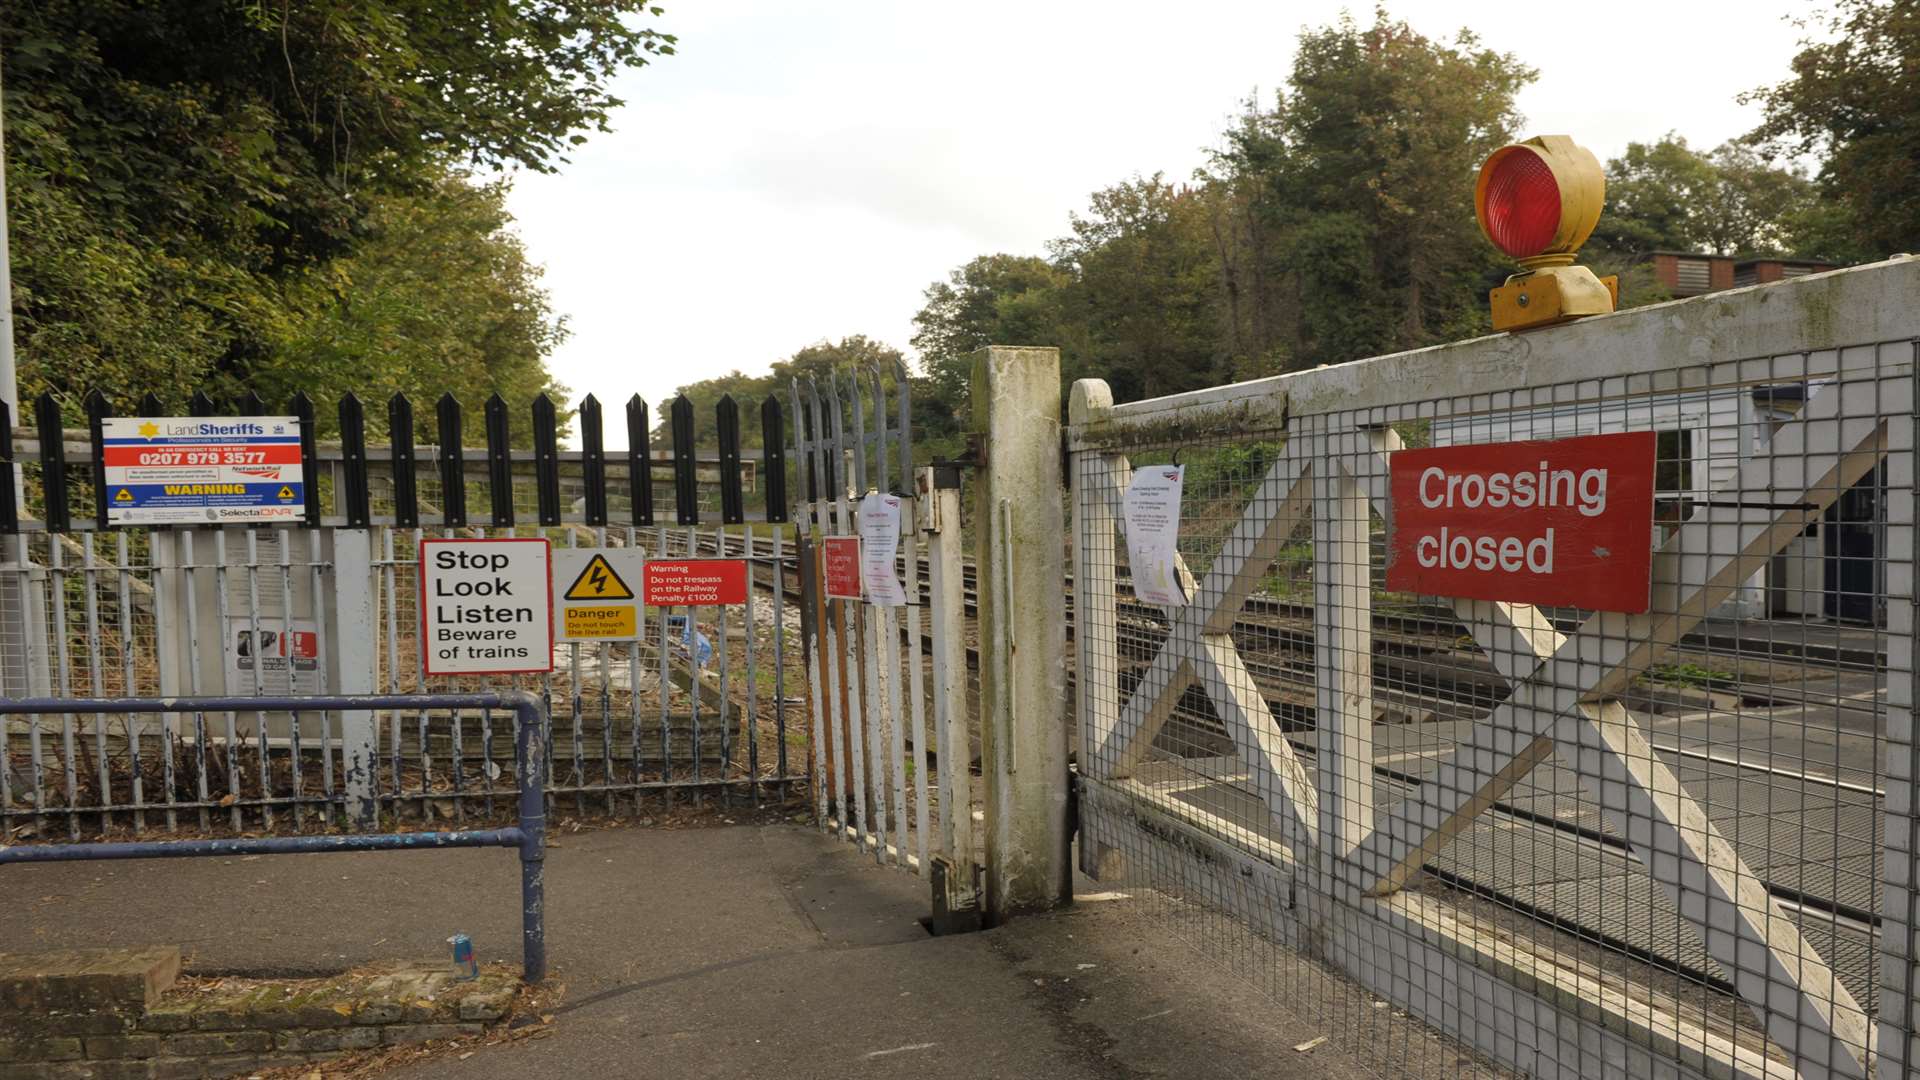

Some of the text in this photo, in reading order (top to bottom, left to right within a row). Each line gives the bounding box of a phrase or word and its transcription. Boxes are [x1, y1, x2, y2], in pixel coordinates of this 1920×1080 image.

[167, 424, 264, 436] LandSheriffs
[139, 452, 266, 465] 0207 979 3577
[164, 484, 246, 496] WARNING
[1419, 461, 1608, 517] Crossing
[1416, 527, 1555, 574] closed
[436, 550, 509, 573] Stop
[650, 565, 689, 573] Warning
[651, 576, 722, 584] Do not trespass
[436, 577, 513, 597] Look
[665, 585, 681, 593] the
[683, 585, 718, 594] Railway
[651, 594, 718, 603] Penalty £1000
[437, 604, 533, 624] Listen
[568, 609, 621, 620] Danger
[438, 628, 517, 641] Beware
[439, 645, 529, 659] of trains
